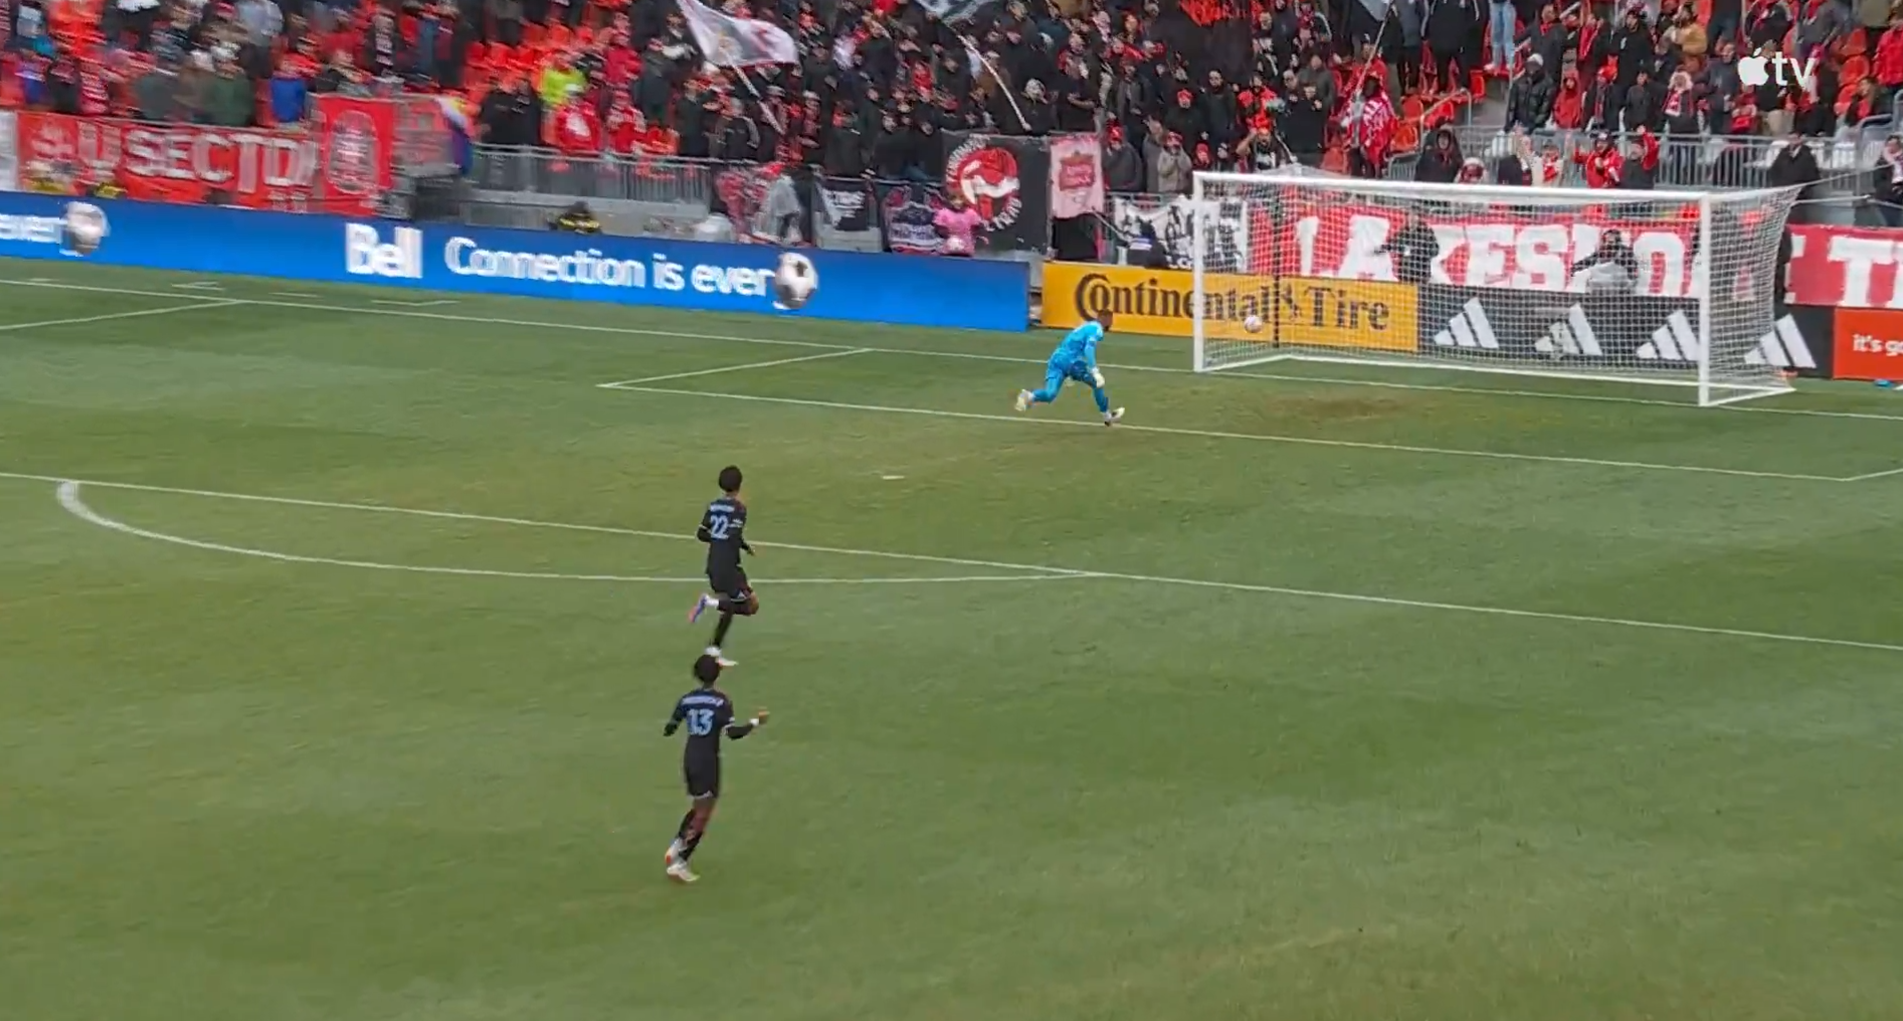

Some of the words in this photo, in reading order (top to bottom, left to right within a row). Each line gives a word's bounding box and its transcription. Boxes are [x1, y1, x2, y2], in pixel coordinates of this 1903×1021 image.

[345, 222, 422, 281] Bell
[445, 237, 646, 288] Connection
[653, 251, 684, 292] is
[691, 262, 776, 297] ever
[1076, 273, 1271, 326] Continental
[1304, 286, 1390, 331] Tire
[1853, 334, 1882, 352] it's
[711, 515, 729, 540] 22
